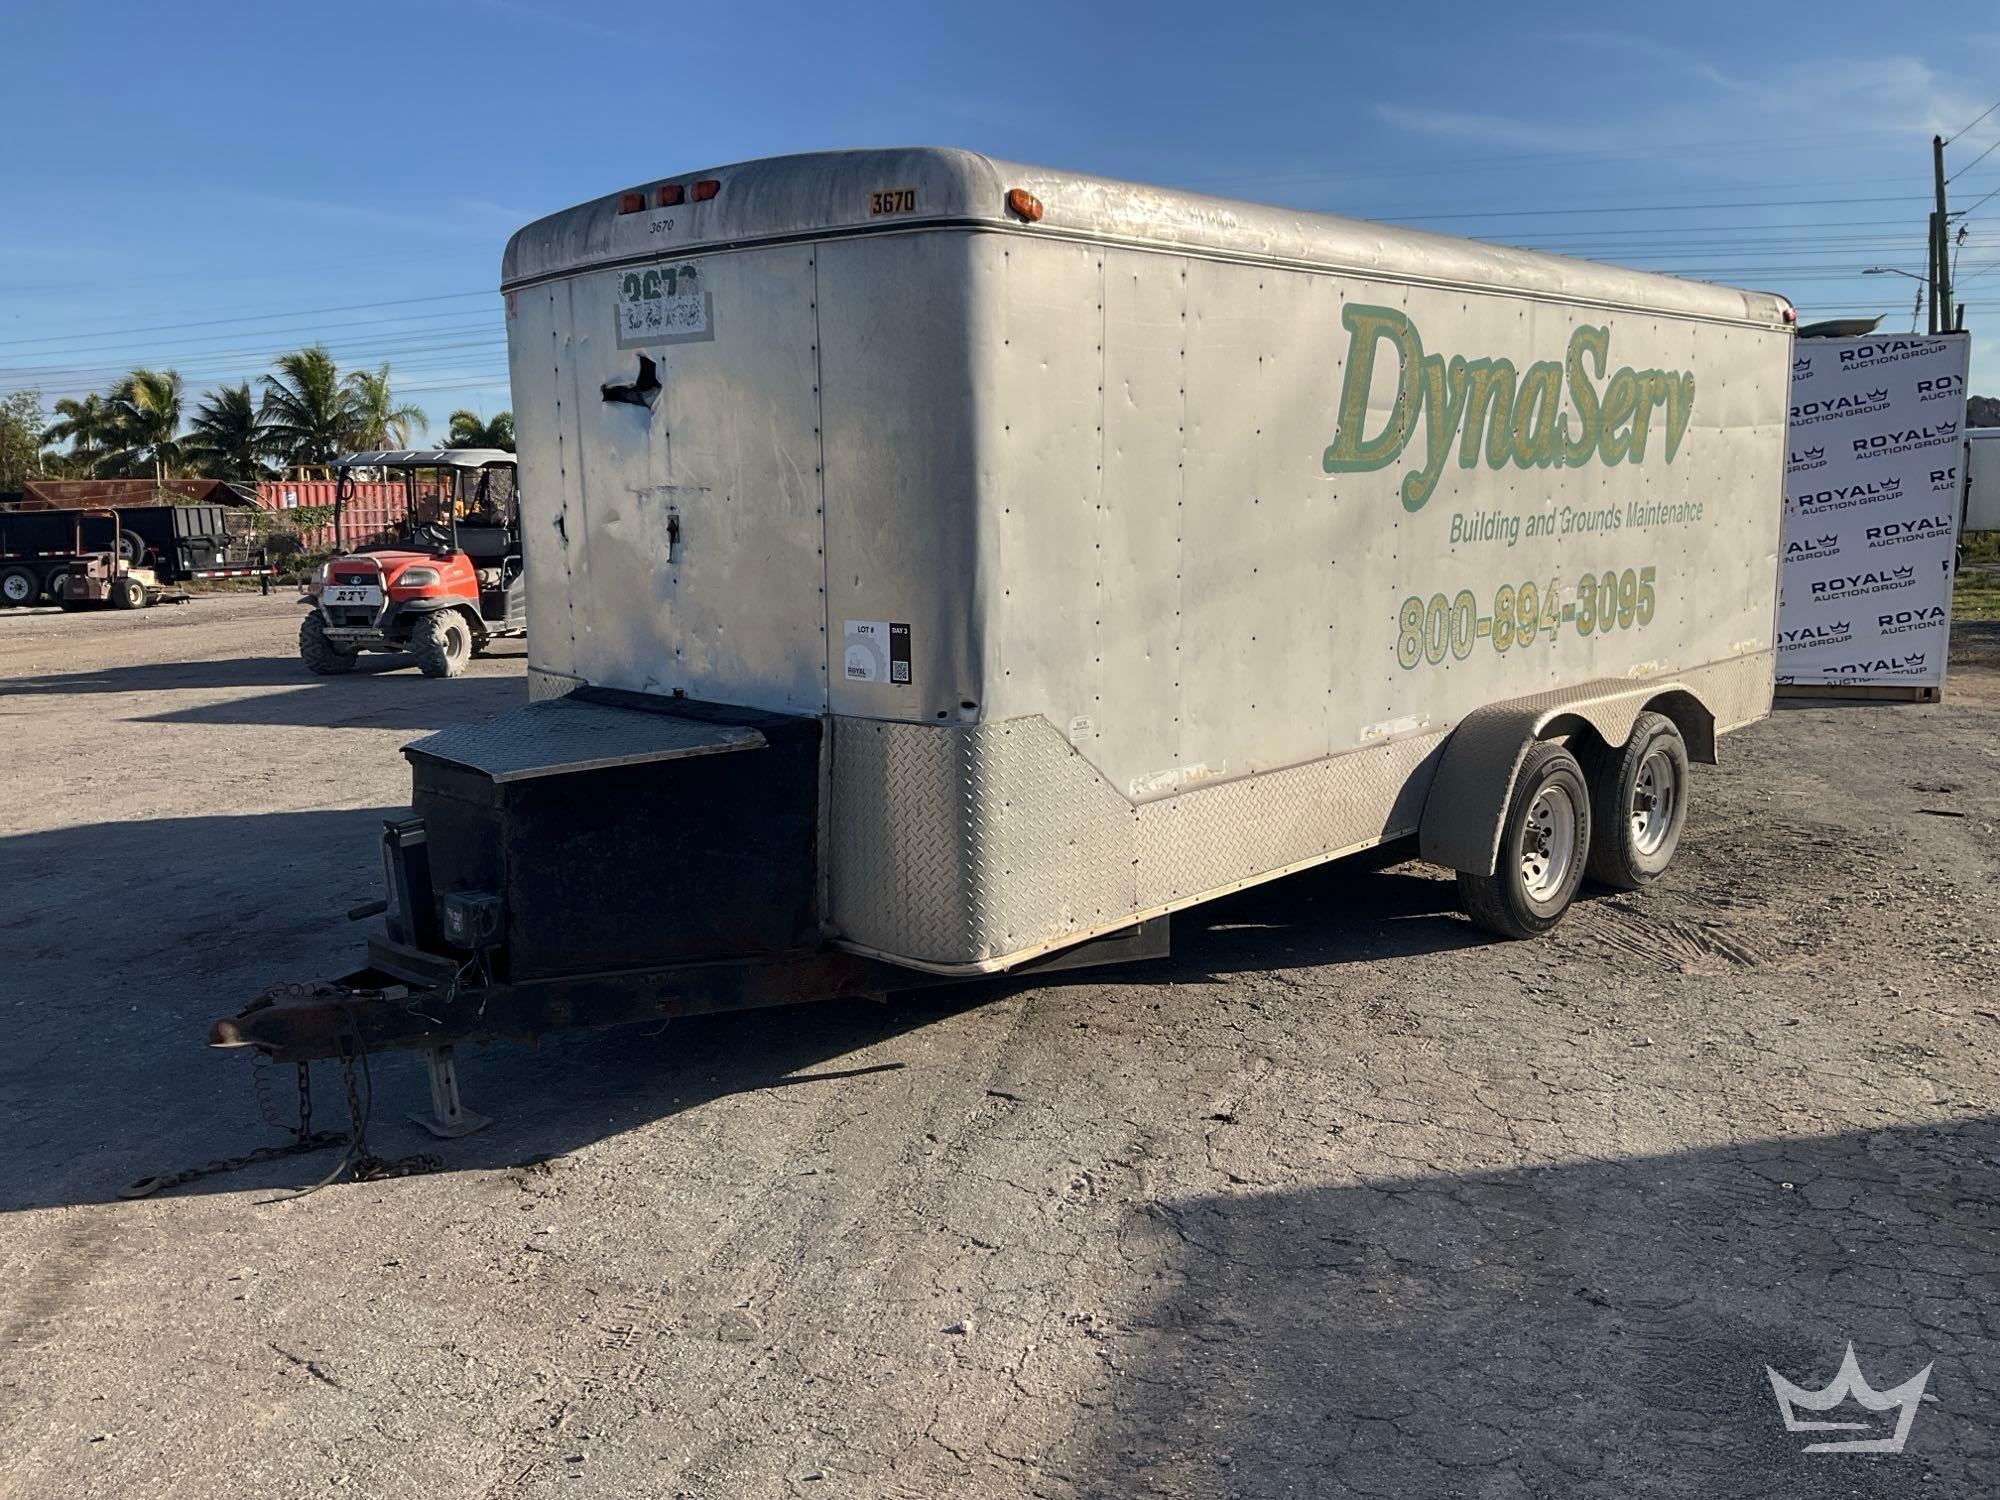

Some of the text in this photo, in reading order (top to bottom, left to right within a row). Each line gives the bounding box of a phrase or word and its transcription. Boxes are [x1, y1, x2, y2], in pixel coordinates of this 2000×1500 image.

[872, 190, 915, 215] 3670
[650, 219, 674, 234] 3670
[1840, 341, 1923, 363] ROYAL
[1843, 344, 1947, 371] AUCTION GROUP
[1322, 302, 1695, 513] DynaServ
[1790, 395, 1867, 417] ROYAL
[1790, 402, 1890, 427] AUCTION GROUP
[1853, 427, 1935, 451] ROYAL
[1855, 434, 1958, 460] AUCTION GROUP
[1799, 483, 1880, 507] ROYAL
[1802, 491, 1903, 516] AUCTION GROUP
[1449, 500, 1703, 547] Building and Grounds Maintenance
[1866, 516, 1948, 539] ROYAL
[1869, 533, 1924, 548] AUCTION
[1796, 548, 1840, 561] GROUP
[1811, 571, 1893, 593] ROYAL
[1814, 579, 1916, 602] AUCTION GROUP
[1397, 566, 1656, 670] 800-894-3095
[1881, 621, 1936, 635] AUCTION
[1809, 635, 1852, 648] GROUP
[848, 667, 866, 675] ROYAL
